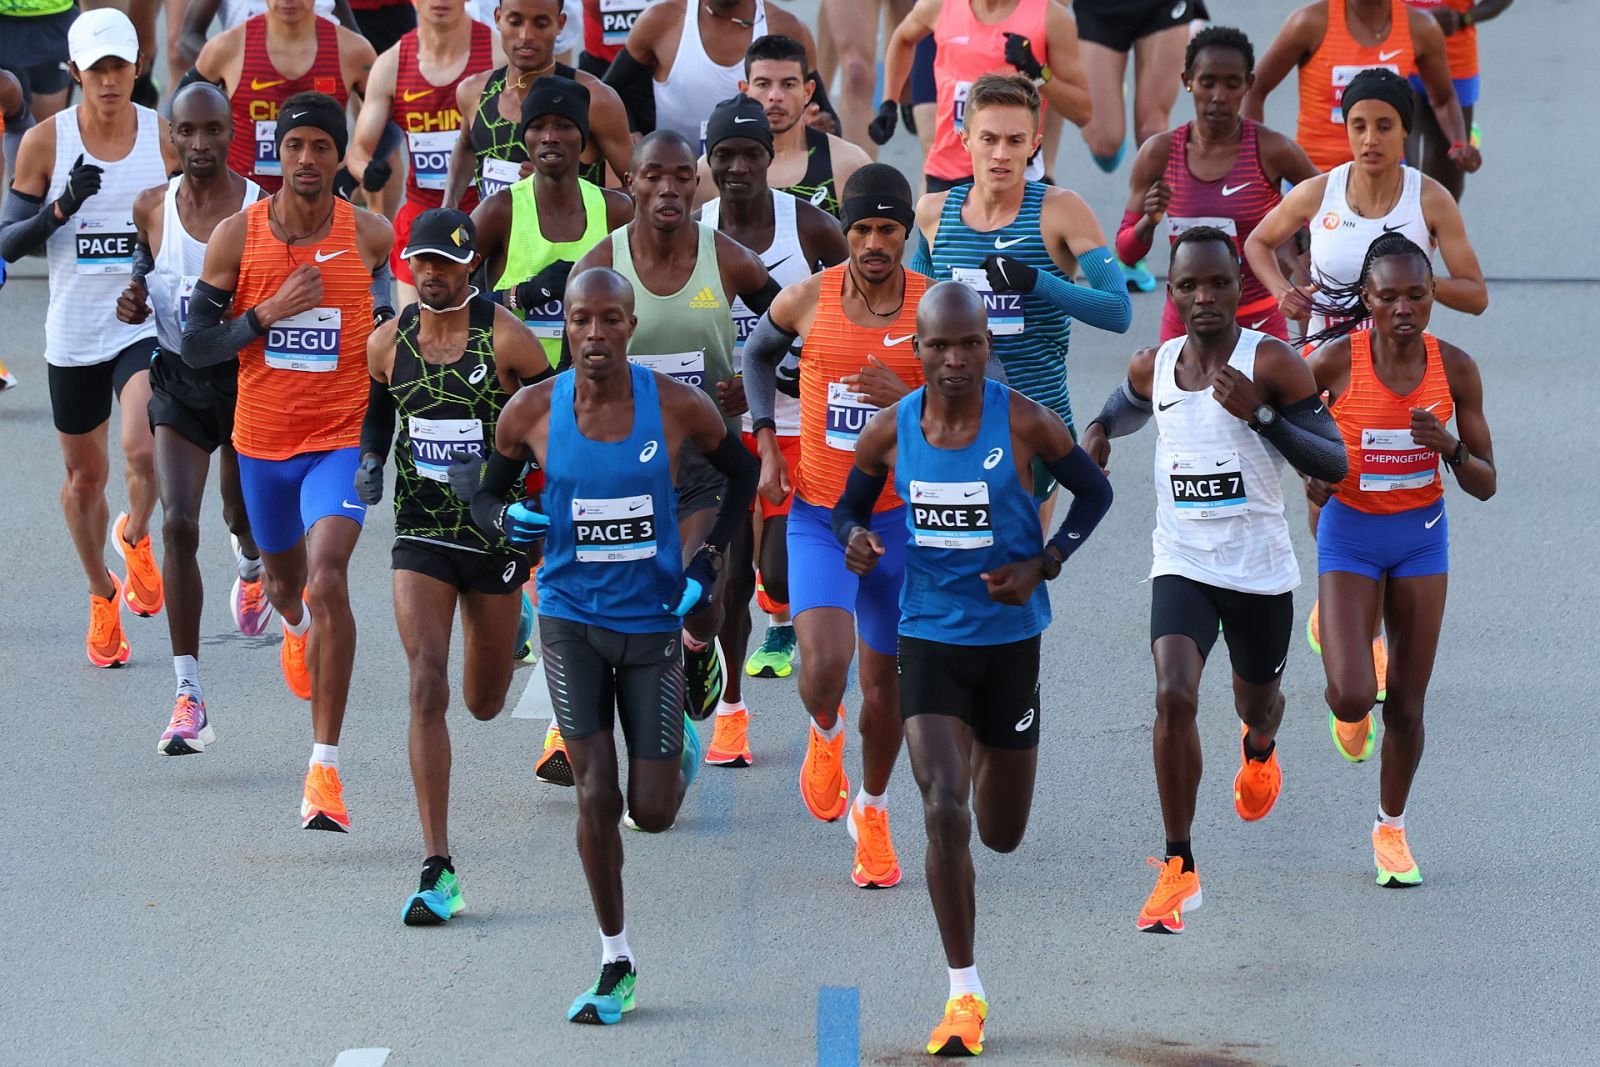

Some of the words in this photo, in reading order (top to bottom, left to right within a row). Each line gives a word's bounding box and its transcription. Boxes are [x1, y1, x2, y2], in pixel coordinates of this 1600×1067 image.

[78, 238, 130, 255] PACE
[688, 301, 720, 309] adidas
[734, 318, 759, 337] IS
[268, 329, 337, 351] DEGU
[674, 375, 702, 386] TO
[411, 439, 483, 461] YIMER
[1364, 451, 1435, 464] CHEPNGETICH
[1172, 479, 1224, 498] PACE
[1227, 477, 1240, 494] 7
[914, 508, 970, 527] PACE
[974, 509, 989, 527] 2
[576, 523, 634, 541] PACE
[639, 521, 653, 537] 3
